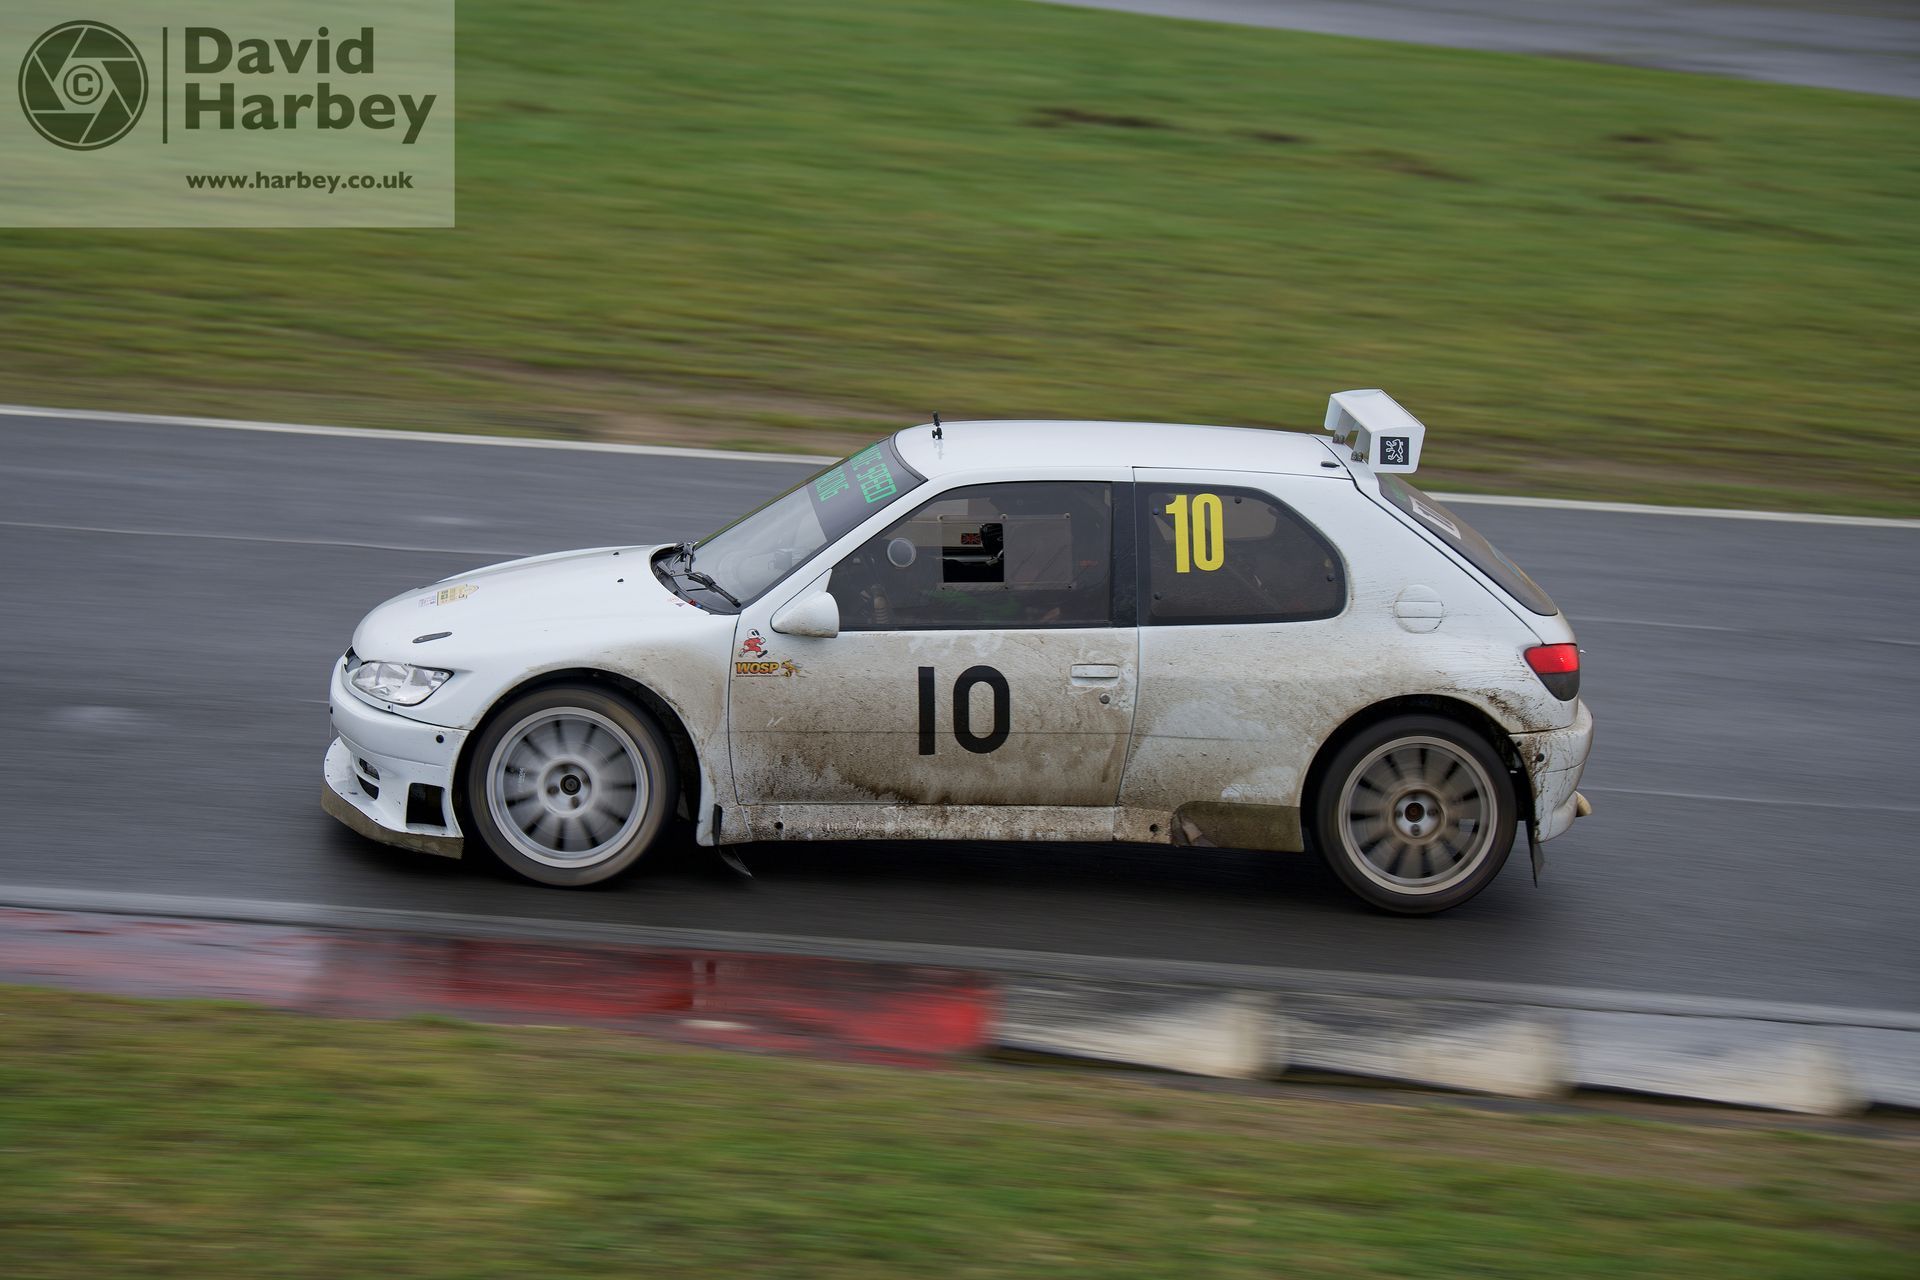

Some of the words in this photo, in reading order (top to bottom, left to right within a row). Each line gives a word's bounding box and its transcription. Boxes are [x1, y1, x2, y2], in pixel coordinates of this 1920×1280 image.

[1165, 493, 1225, 573] 10
[735, 662, 779, 674] WOSP
[918, 665, 1010, 756] 10
